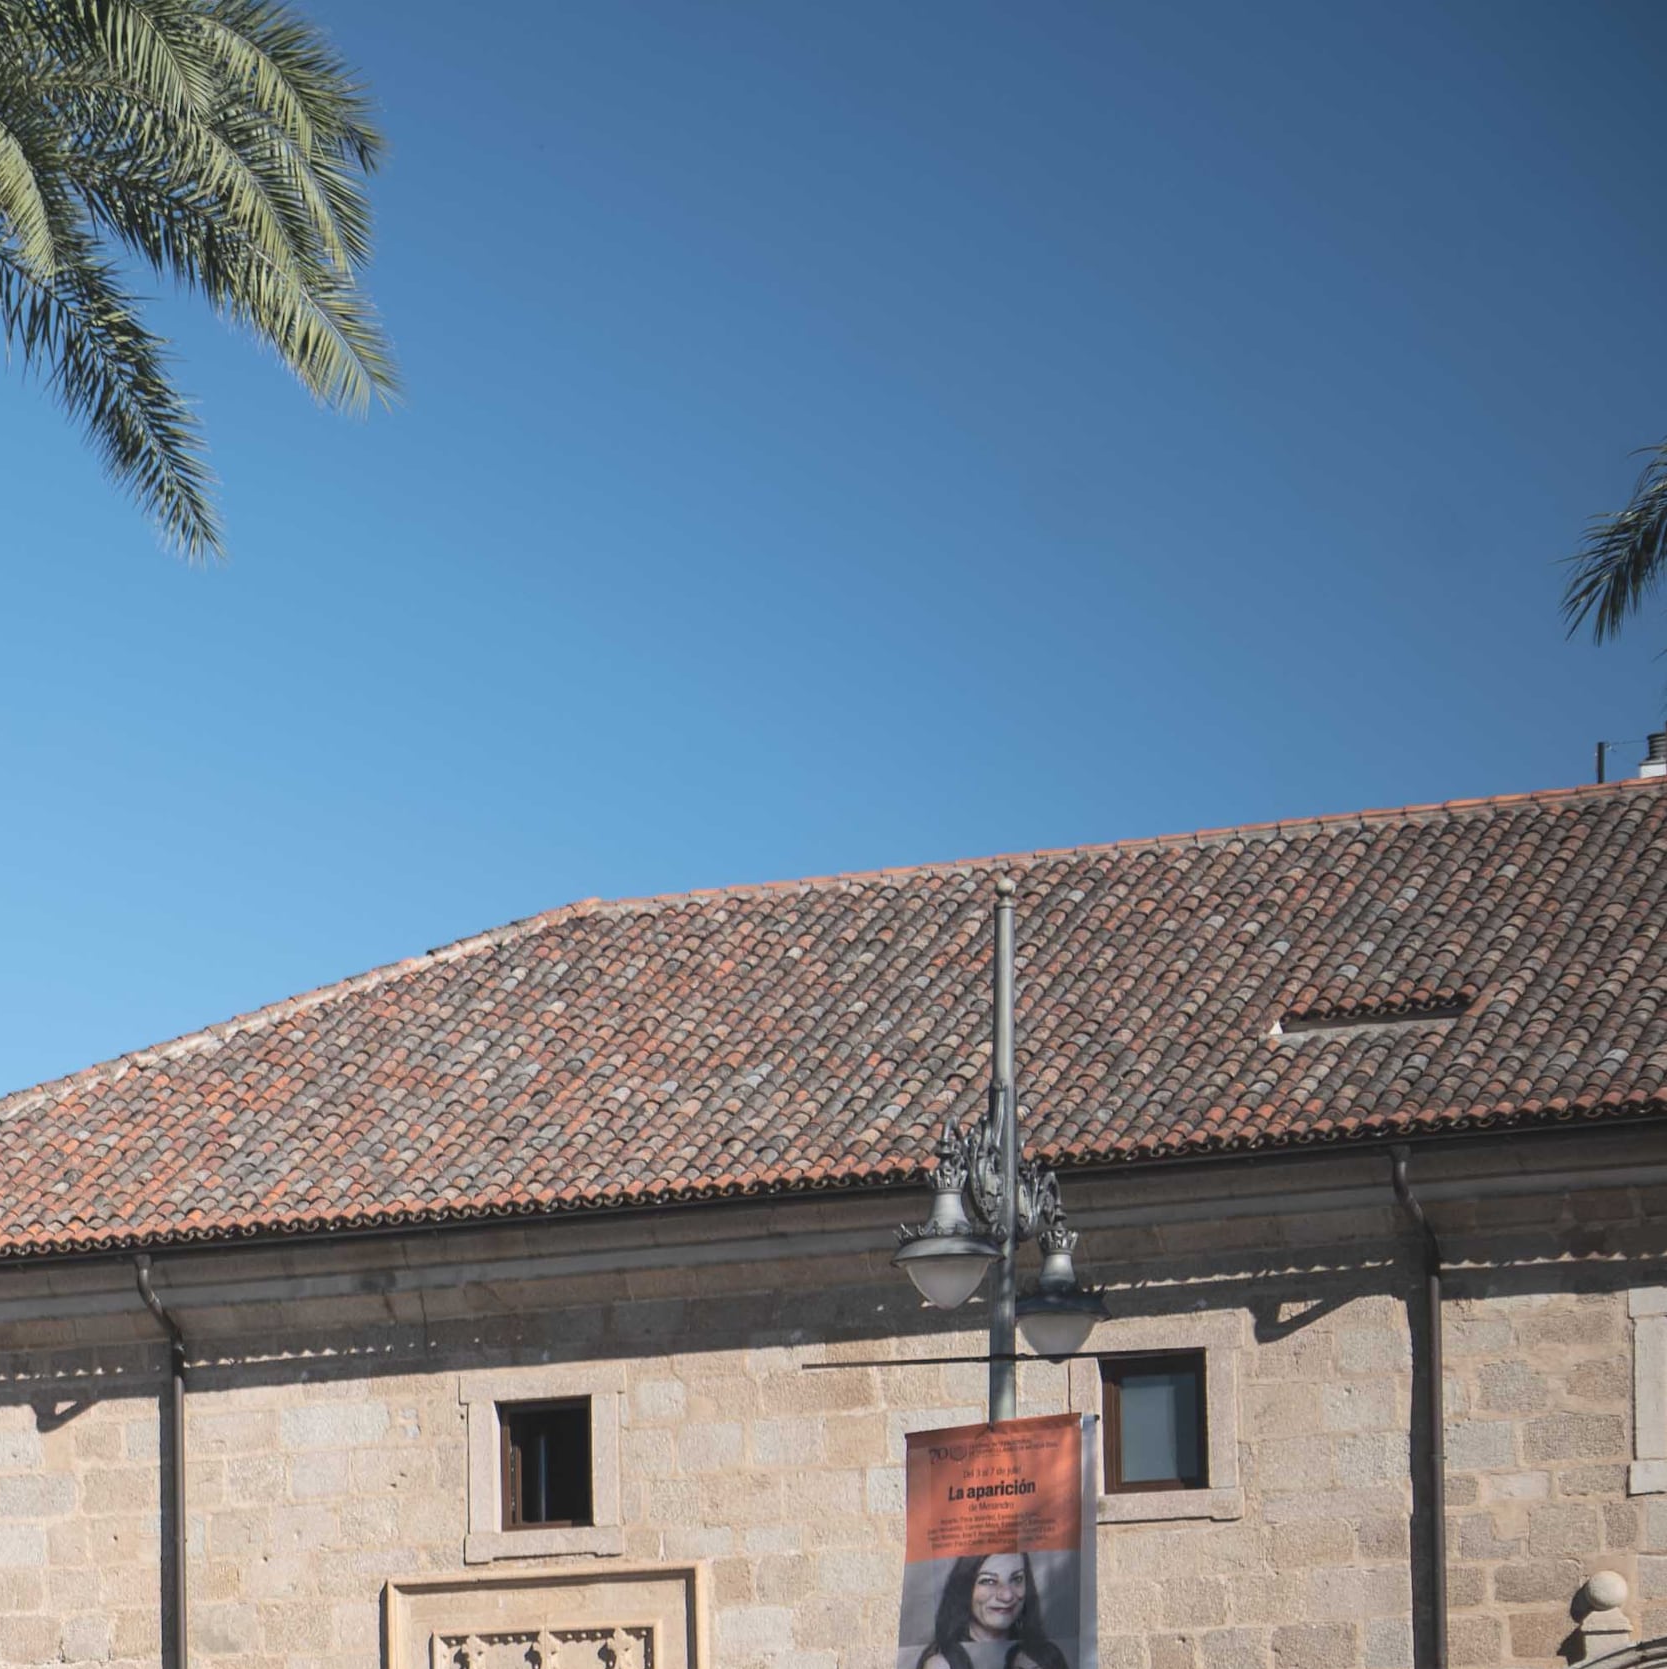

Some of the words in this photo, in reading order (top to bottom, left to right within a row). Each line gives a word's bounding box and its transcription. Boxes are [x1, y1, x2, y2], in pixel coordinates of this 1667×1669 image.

[948, 1485, 964, 1502] La
[966, 1479, 1036, 1501] aparición
[968, 1502, 977, 1512] de
